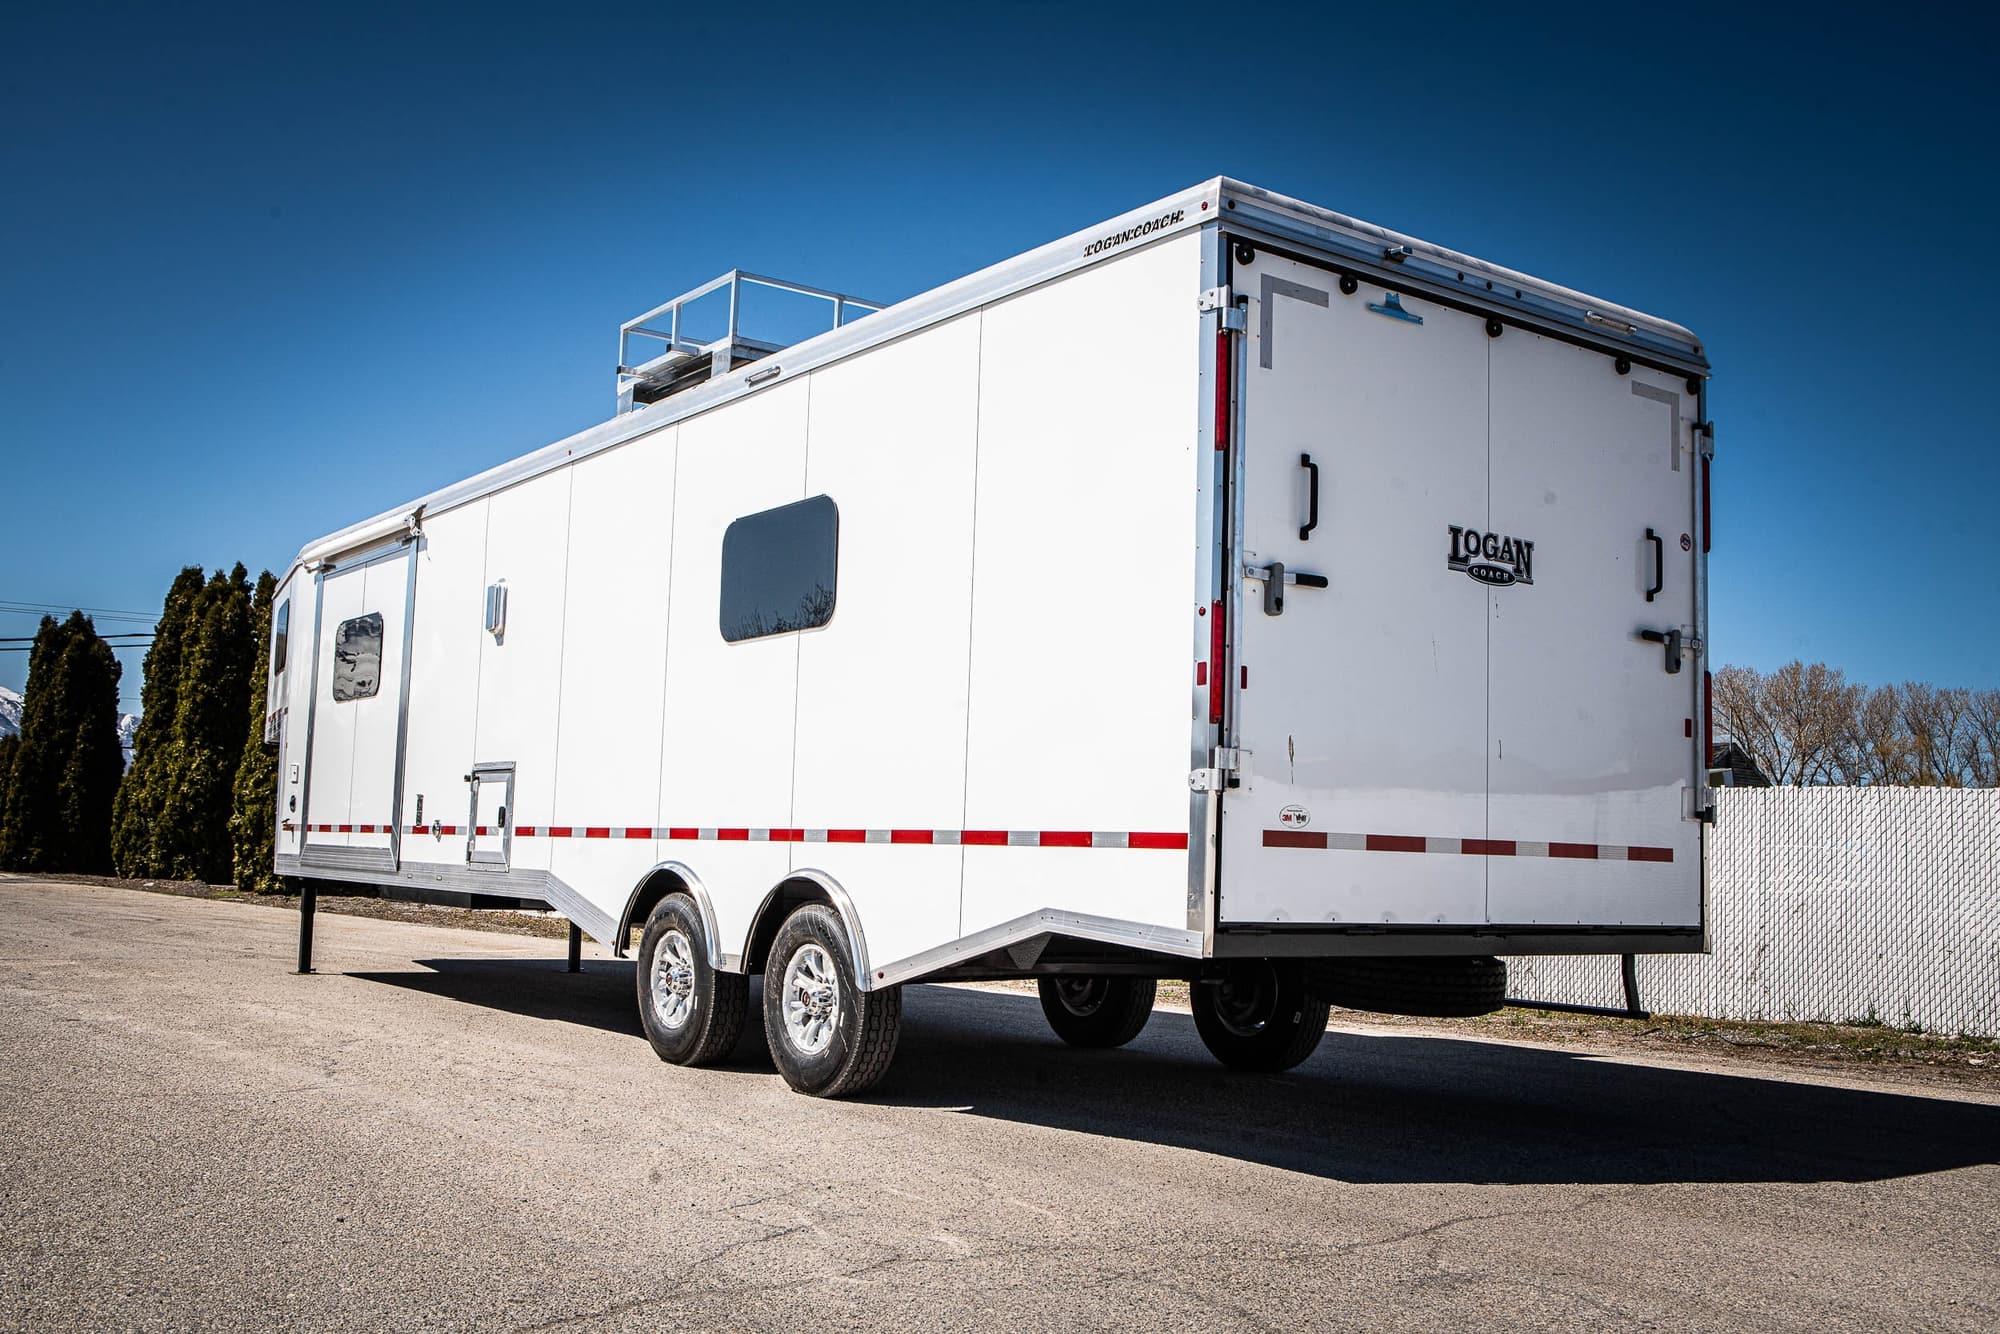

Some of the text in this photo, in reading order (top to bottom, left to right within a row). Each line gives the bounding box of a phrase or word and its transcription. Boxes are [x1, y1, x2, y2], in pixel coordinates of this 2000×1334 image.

[1083, 210, 1184, 257] LOGAN COACH
[1447, 525, 1534, 579] LOGAN
[1473, 567, 1509, 581] COACH
